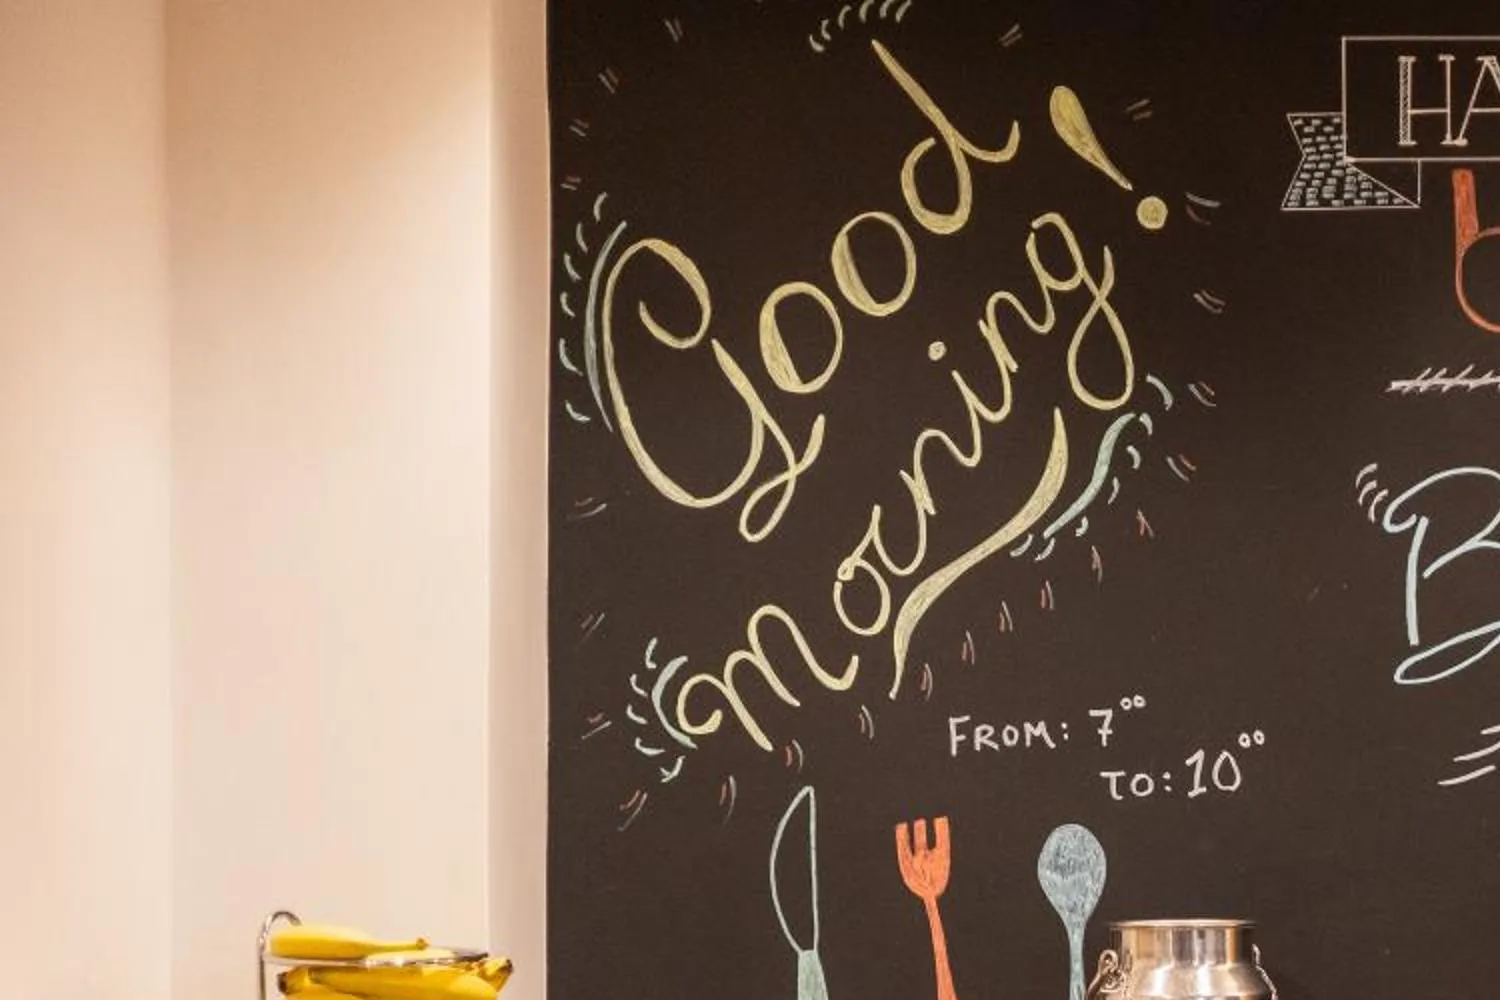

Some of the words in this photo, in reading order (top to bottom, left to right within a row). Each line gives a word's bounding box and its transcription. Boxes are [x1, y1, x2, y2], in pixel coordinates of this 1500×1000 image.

[602, 38, 1020, 543] Good
[948, 714, 1069, 757] FROM:
[1100, 769, 1172, 801] TO:
